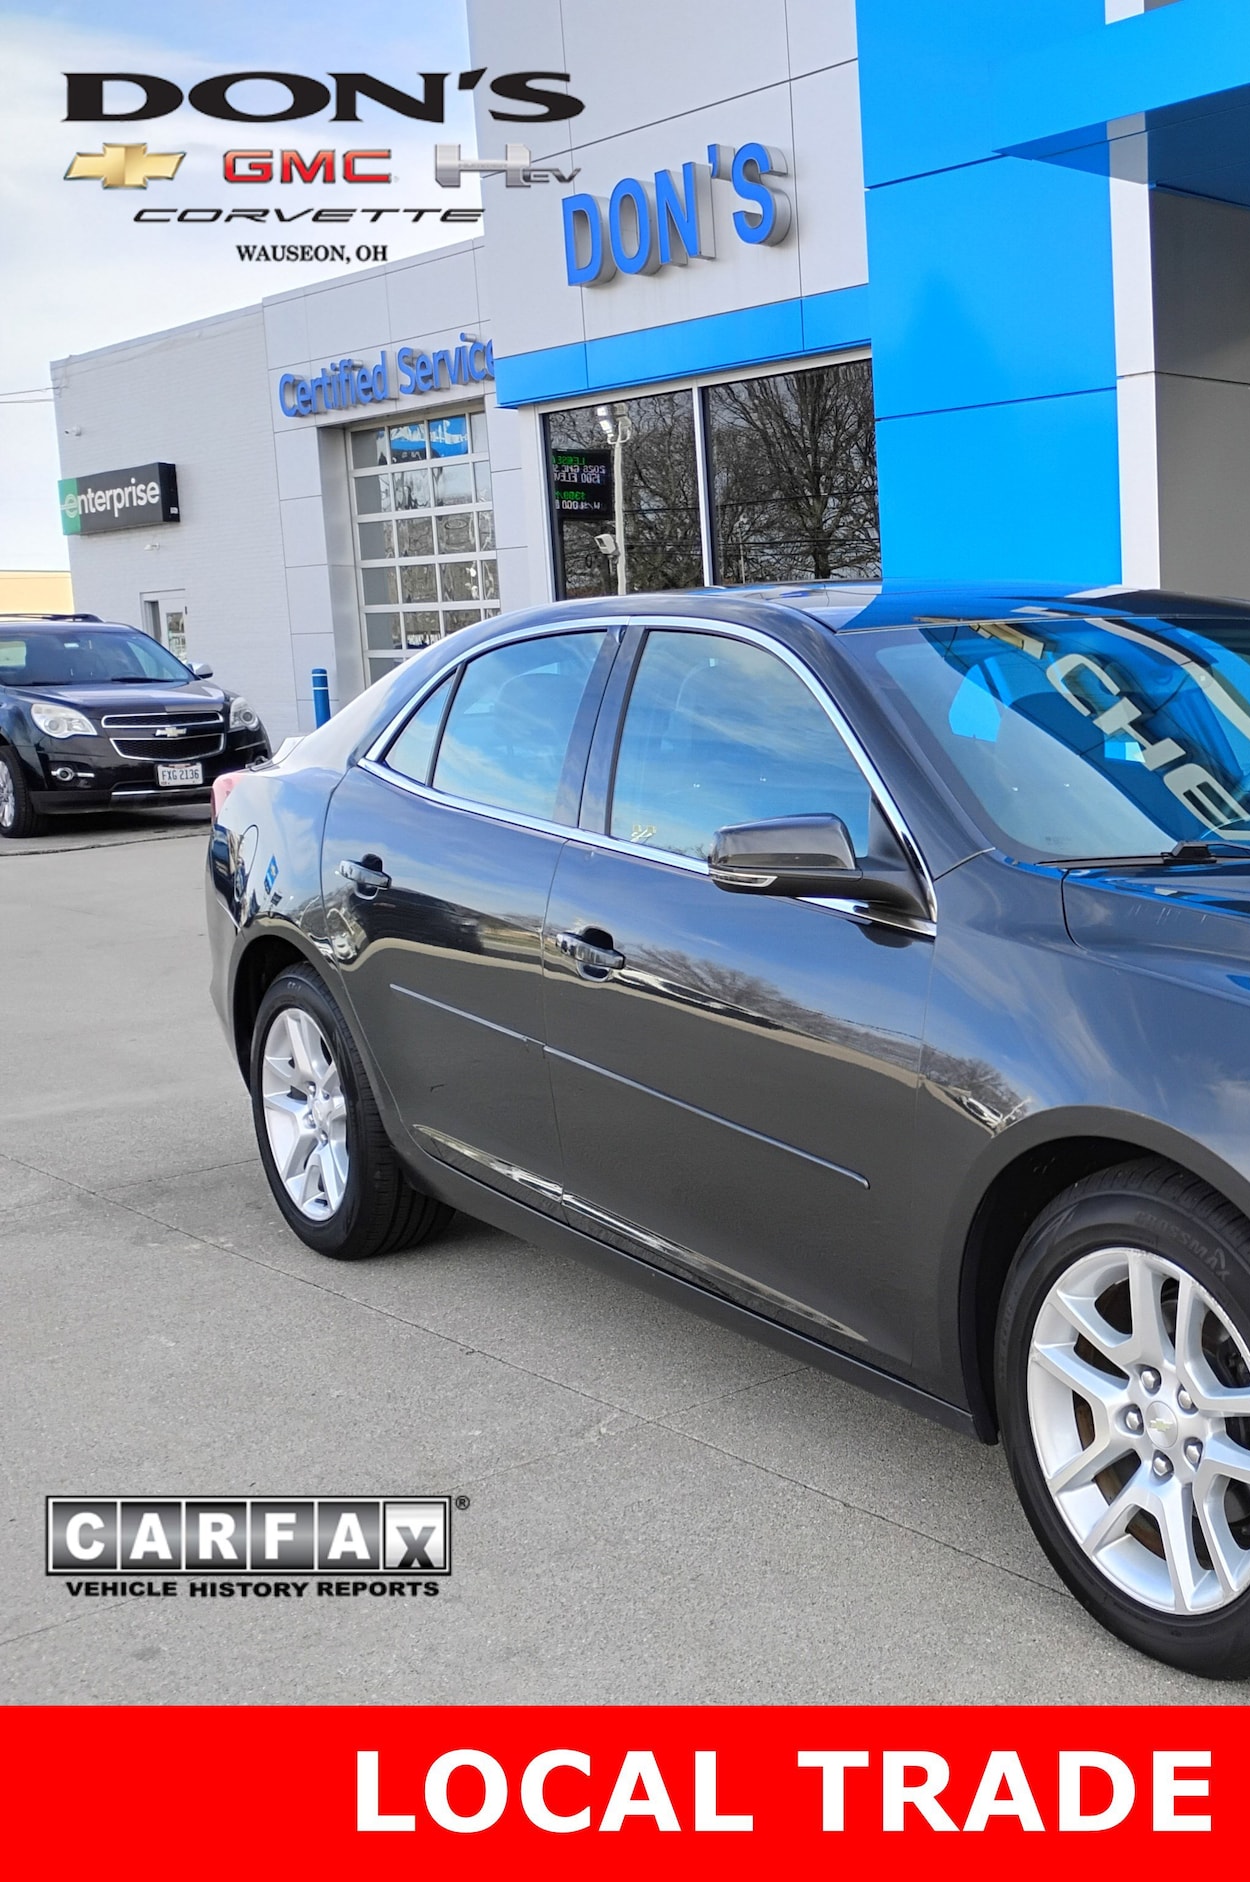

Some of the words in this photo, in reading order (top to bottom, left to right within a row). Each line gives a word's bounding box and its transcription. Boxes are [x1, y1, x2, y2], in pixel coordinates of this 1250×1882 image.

[562, 142, 780, 286] DON'S
[279, 351, 389, 417] Certified
[61, 477, 160, 518] enterprise
[162, 769, 178, 780] FXG
[179, 768, 199, 780] 2136
